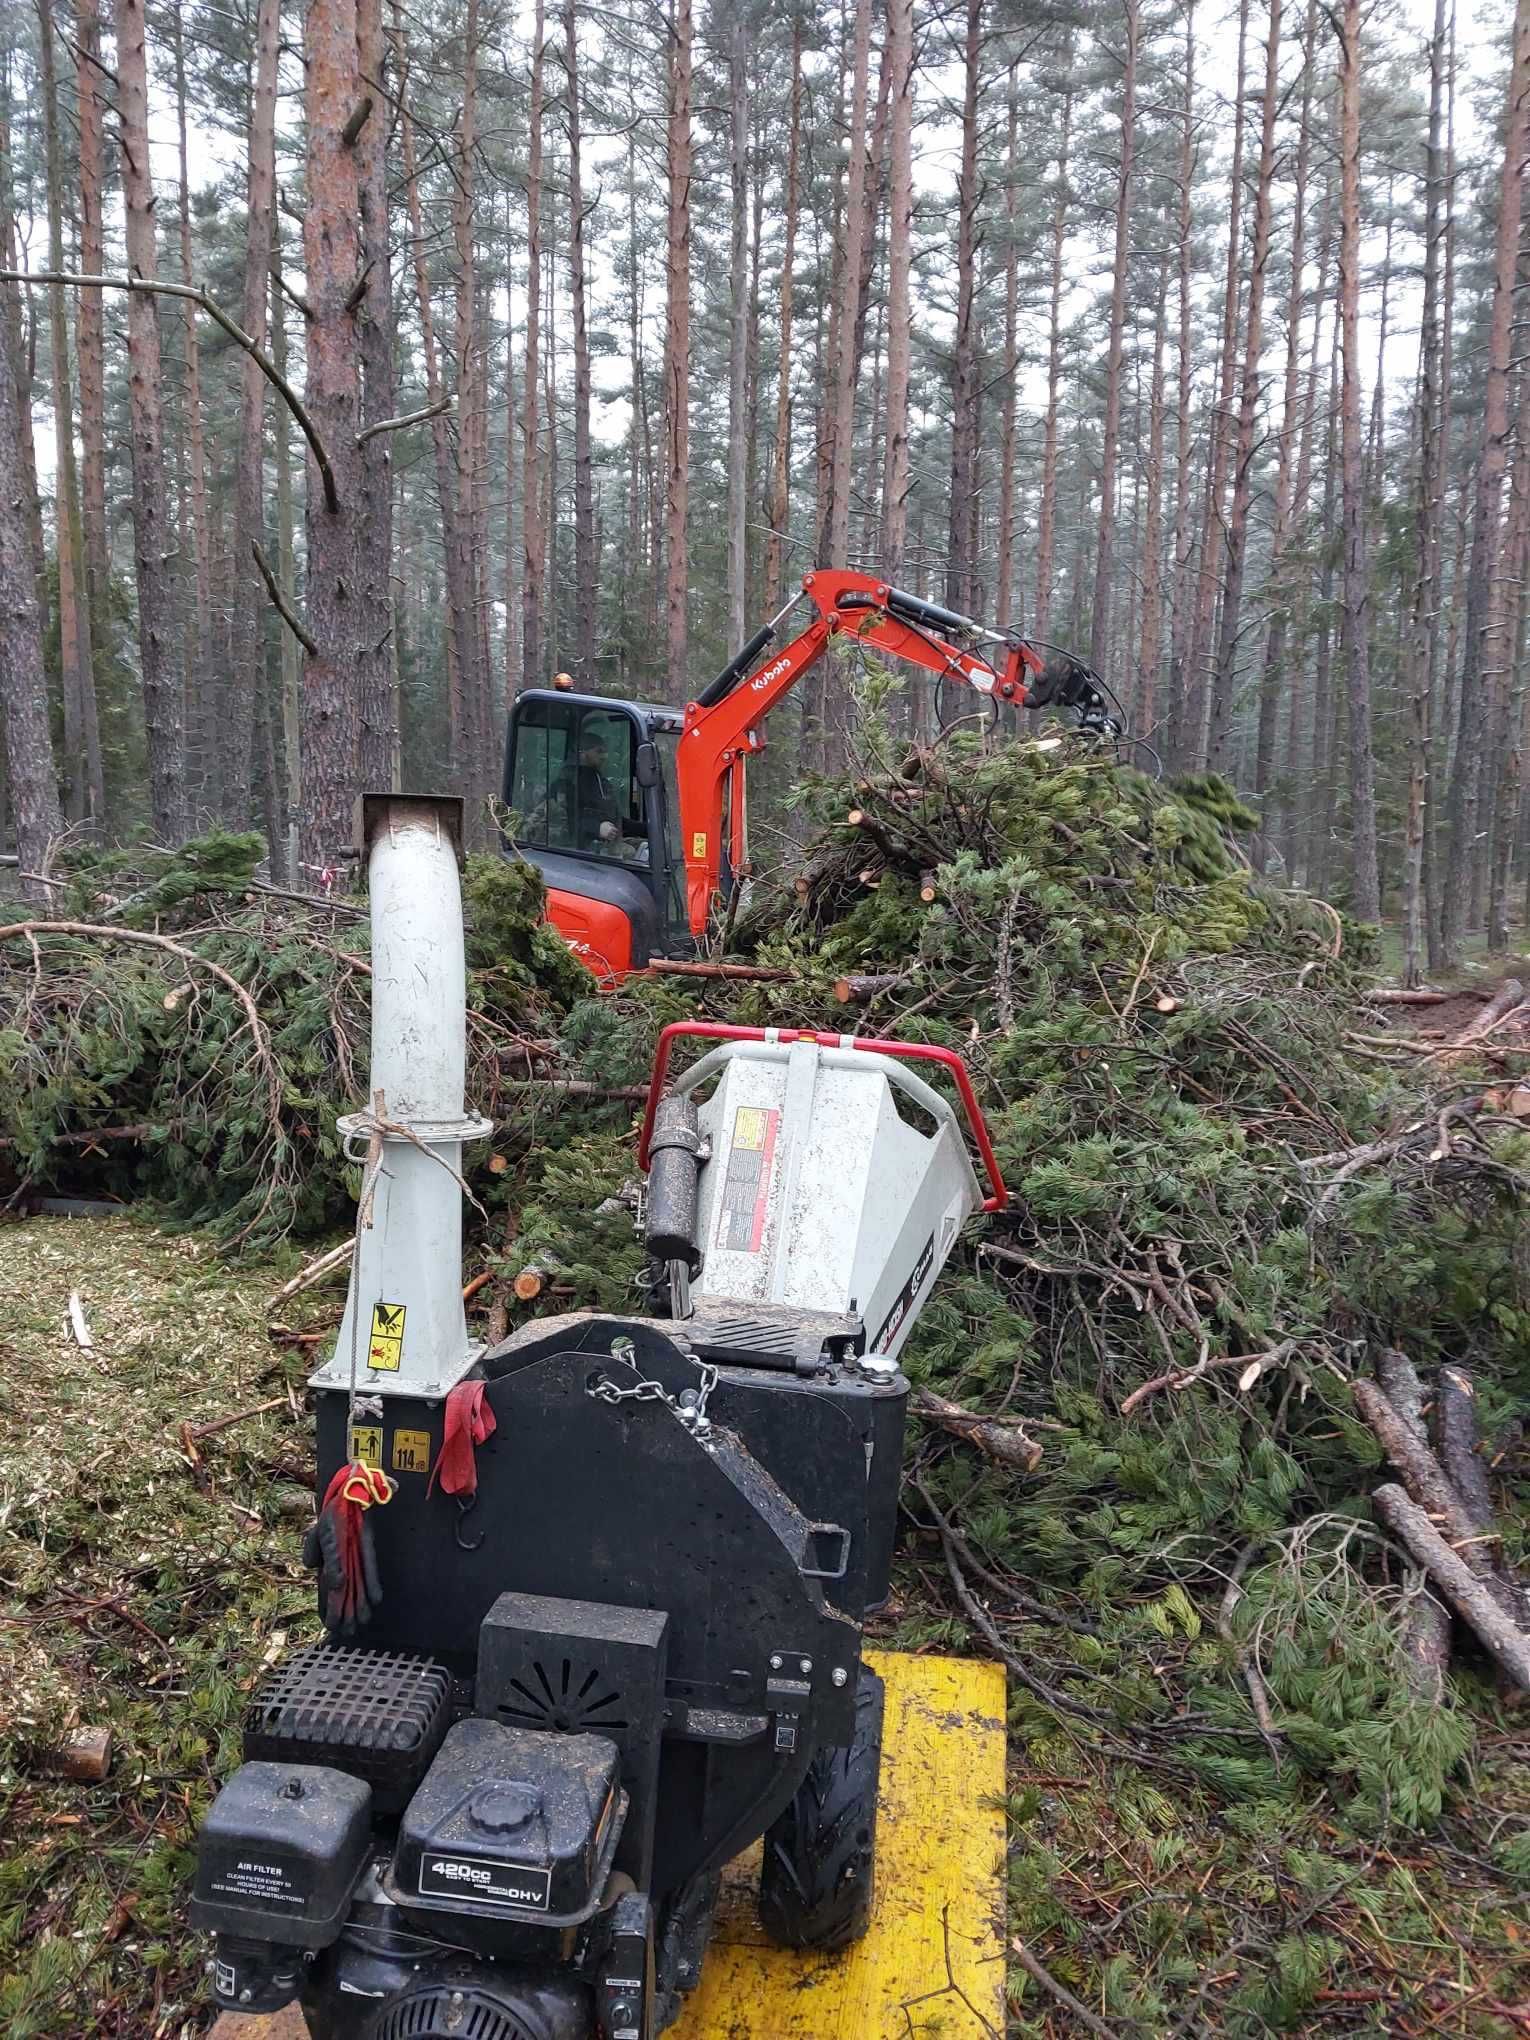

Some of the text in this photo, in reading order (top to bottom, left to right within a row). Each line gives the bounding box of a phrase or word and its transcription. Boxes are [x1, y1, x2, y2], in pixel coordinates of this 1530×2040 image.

[750, 658, 791, 690] Kubota
[396, 1448, 415, 1469] 114
[237, 1862, 282, 1876] AIR FILTER
[431, 1862, 492, 1881] 420cc
[237, 1881, 257, 1889] HOURS
[265, 1878, 284, 1887] EVERY
[225, 1886, 248, 1894] MANUAL
[508, 1888, 543, 1902] OHV
